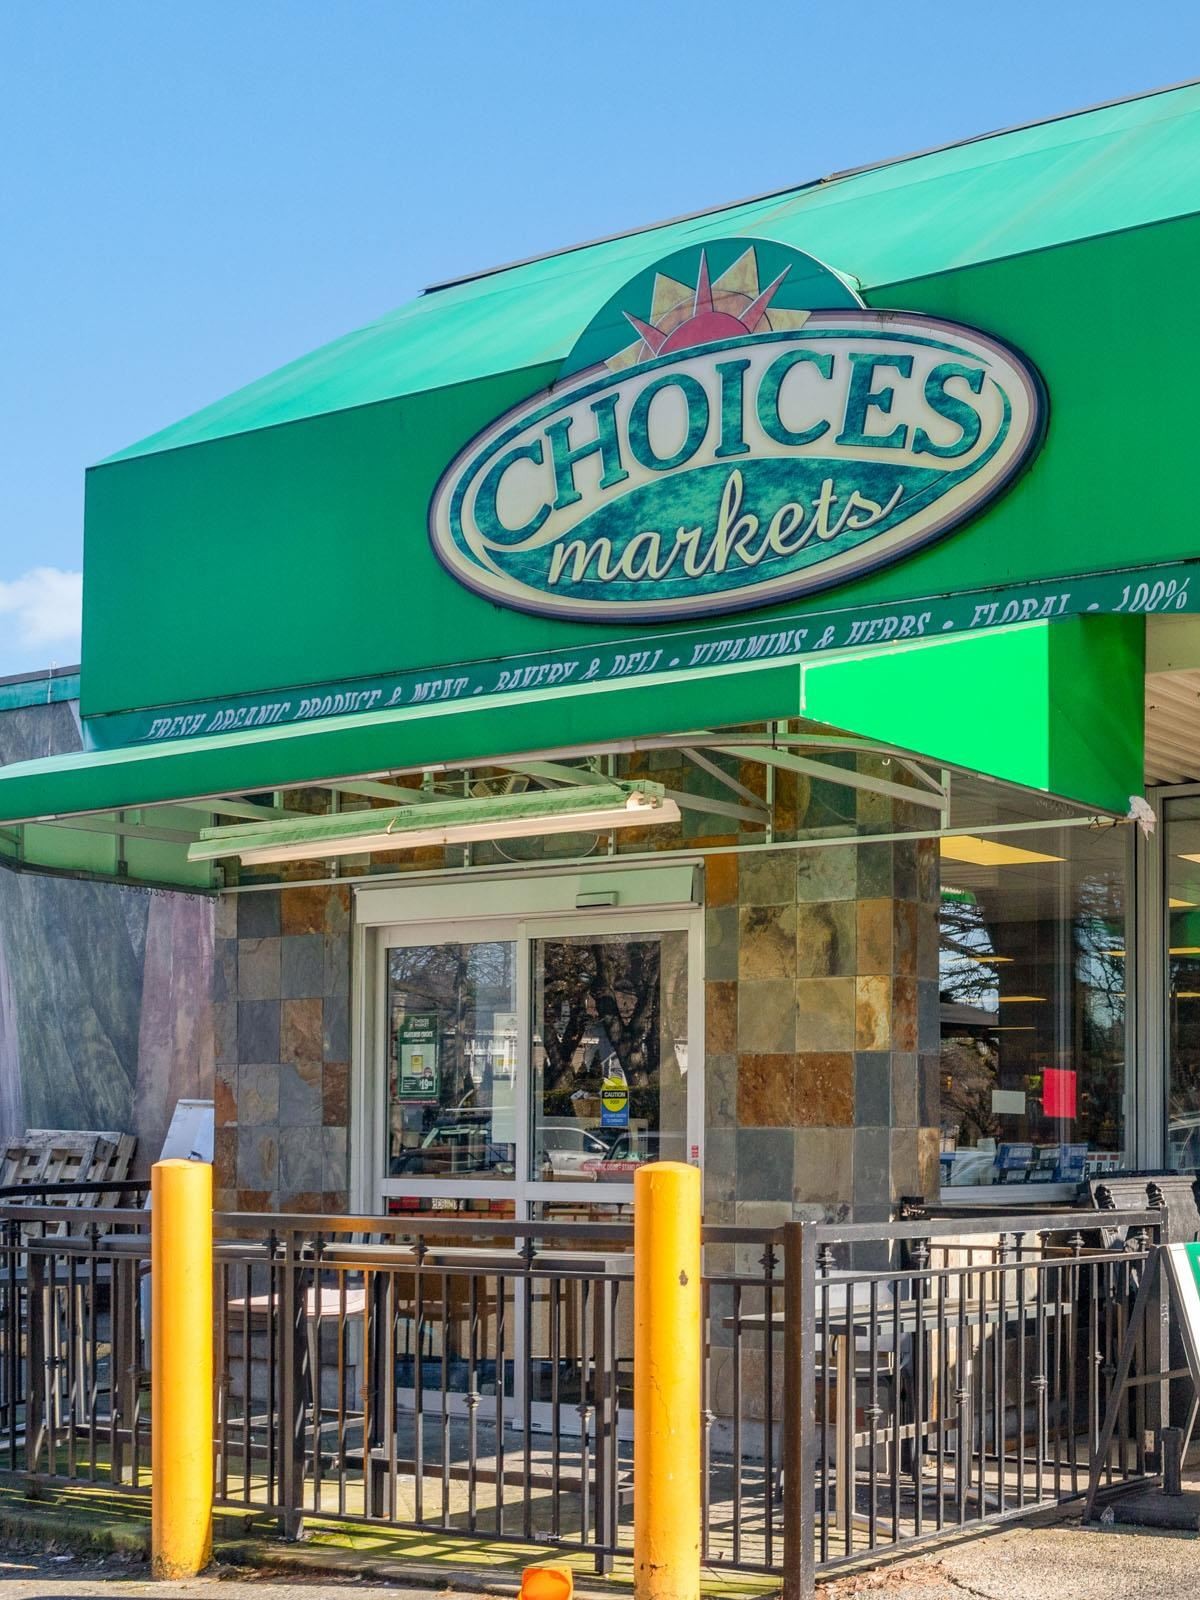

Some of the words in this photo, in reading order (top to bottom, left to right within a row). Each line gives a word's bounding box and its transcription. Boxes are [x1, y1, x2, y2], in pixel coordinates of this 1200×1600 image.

[472, 349, 989, 547] CHOICES
[549, 470, 903, 585] markets
[146, 713, 207, 739] FRESH
[205, 702, 291, 732] ORGANIC
[293, 689, 382, 720] PRODUCE
[384, 686, 402, 707] &
[409, 677, 469, 703] MEAT
[578, 657, 601, 681] &
[607, 649, 663, 677] DELI
[688, 628, 808, 665] VITAMINS
[812, 625, 836, 650] &
[843, 611, 932, 645] HERBS
[969, 593, 1071, 627] FLORAL
[1112, 577, 1190, 612] 100%
